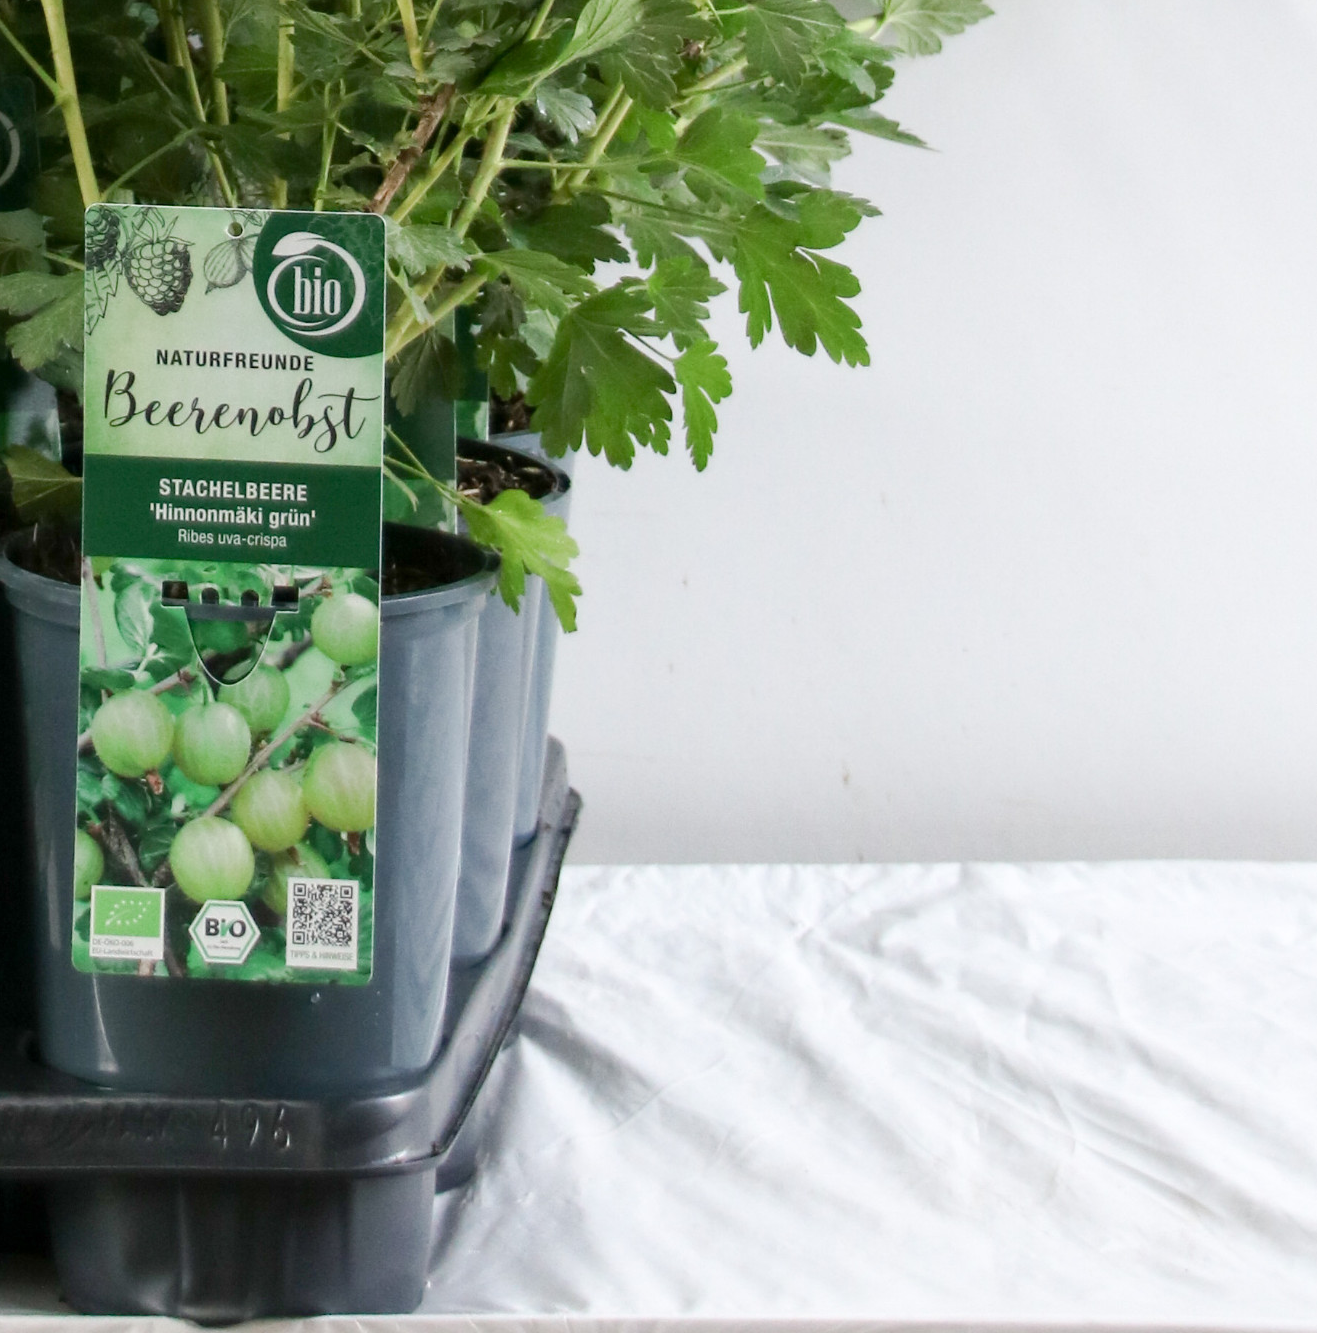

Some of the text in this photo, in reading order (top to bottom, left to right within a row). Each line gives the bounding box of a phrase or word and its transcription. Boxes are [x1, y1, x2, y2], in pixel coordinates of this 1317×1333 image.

[293, 265, 342, 316] bio
[156, 349, 315, 372] NATURFREUNDE
[104, 369, 381, 453] Beerenobst
[158, 477, 309, 503] STACHELBEERE
[149, 501, 317, 529] 'Hinnonmäki grün'
[177, 528, 288, 549] Ribes uva-crispa
[213, 1099, 291, 1151] 496
